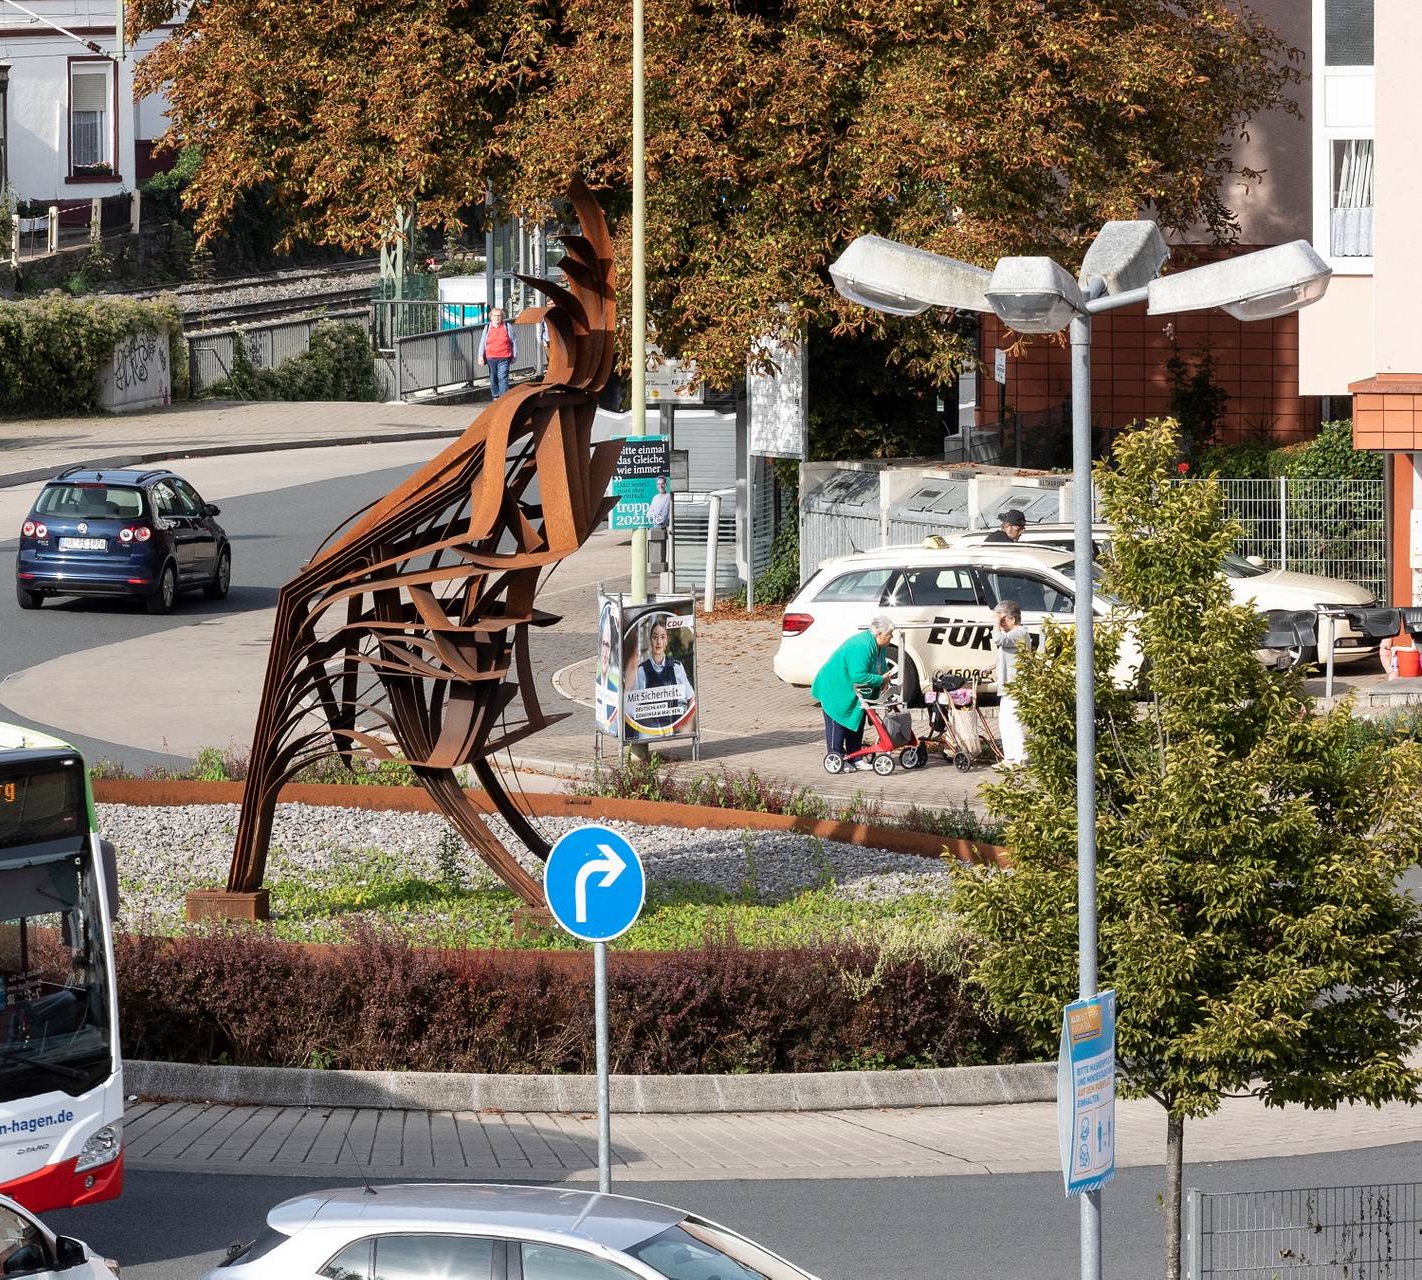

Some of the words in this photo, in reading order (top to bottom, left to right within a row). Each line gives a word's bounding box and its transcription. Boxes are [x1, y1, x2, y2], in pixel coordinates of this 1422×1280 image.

[621, 446, 636, 455] itte
[638, 444, 665, 454] einmal
[617, 455, 631, 465] das
[633, 454, 665, 464] Gleiche,
[617, 466, 633, 474] wie
[634, 465, 661, 474] immer
[617, 503, 650, 515] tropp
[616, 512, 662, 526] 2021.de
[667, 620, 683, 628] CDU
[927, 616, 999, 651] EUR
[627, 693, 640, 702] Mit
[641, 687, 682, 701] Sicherheit.
[635, 704, 666, 713] DEUTSCHLAND
[1076, 1065, 1089, 1076] BITTE
